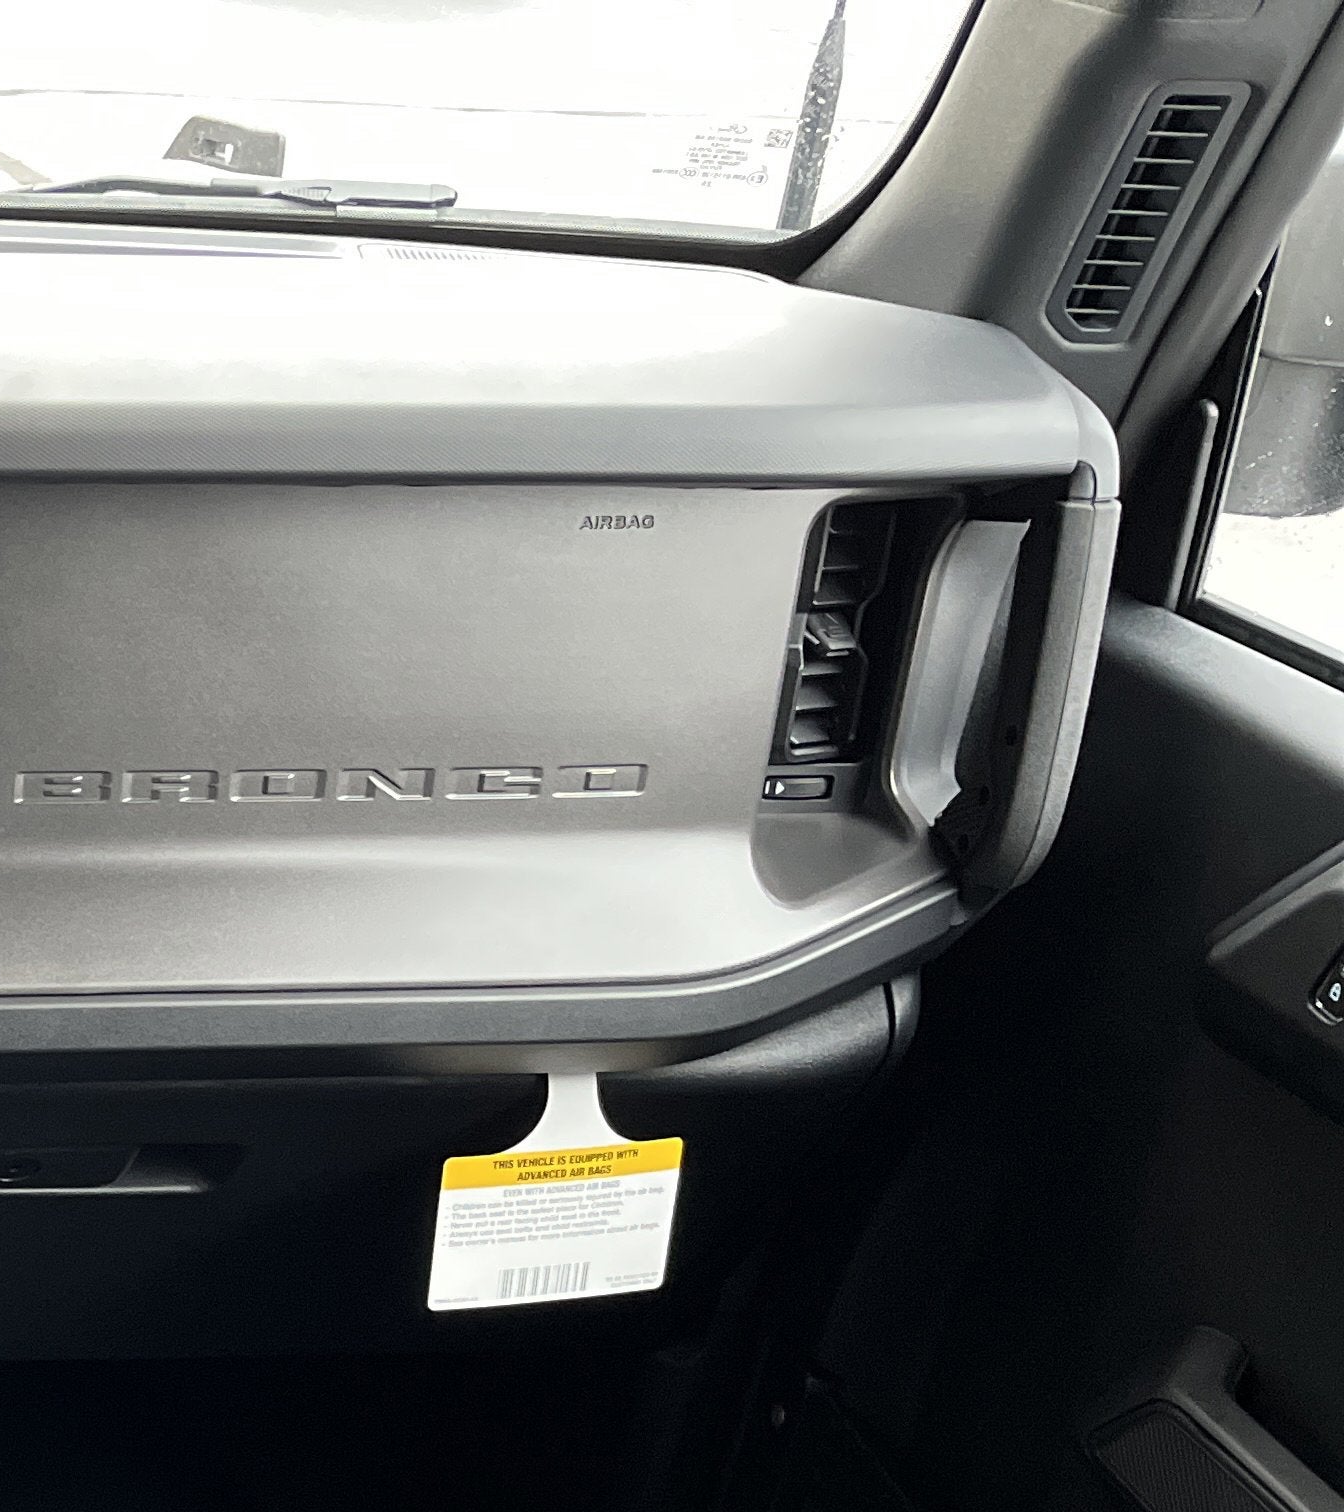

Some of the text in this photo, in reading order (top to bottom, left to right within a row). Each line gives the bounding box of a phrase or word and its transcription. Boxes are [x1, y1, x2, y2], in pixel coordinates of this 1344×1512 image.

[579, 514, 654, 530] AIRBAG
[14, 763, 650, 803] BRONCO
[493, 1149, 639, 1169] THIS VEHICLE IS EQUIPPED WITH
[517, 1165, 612, 1181] ADVANCED AIR BAGS
